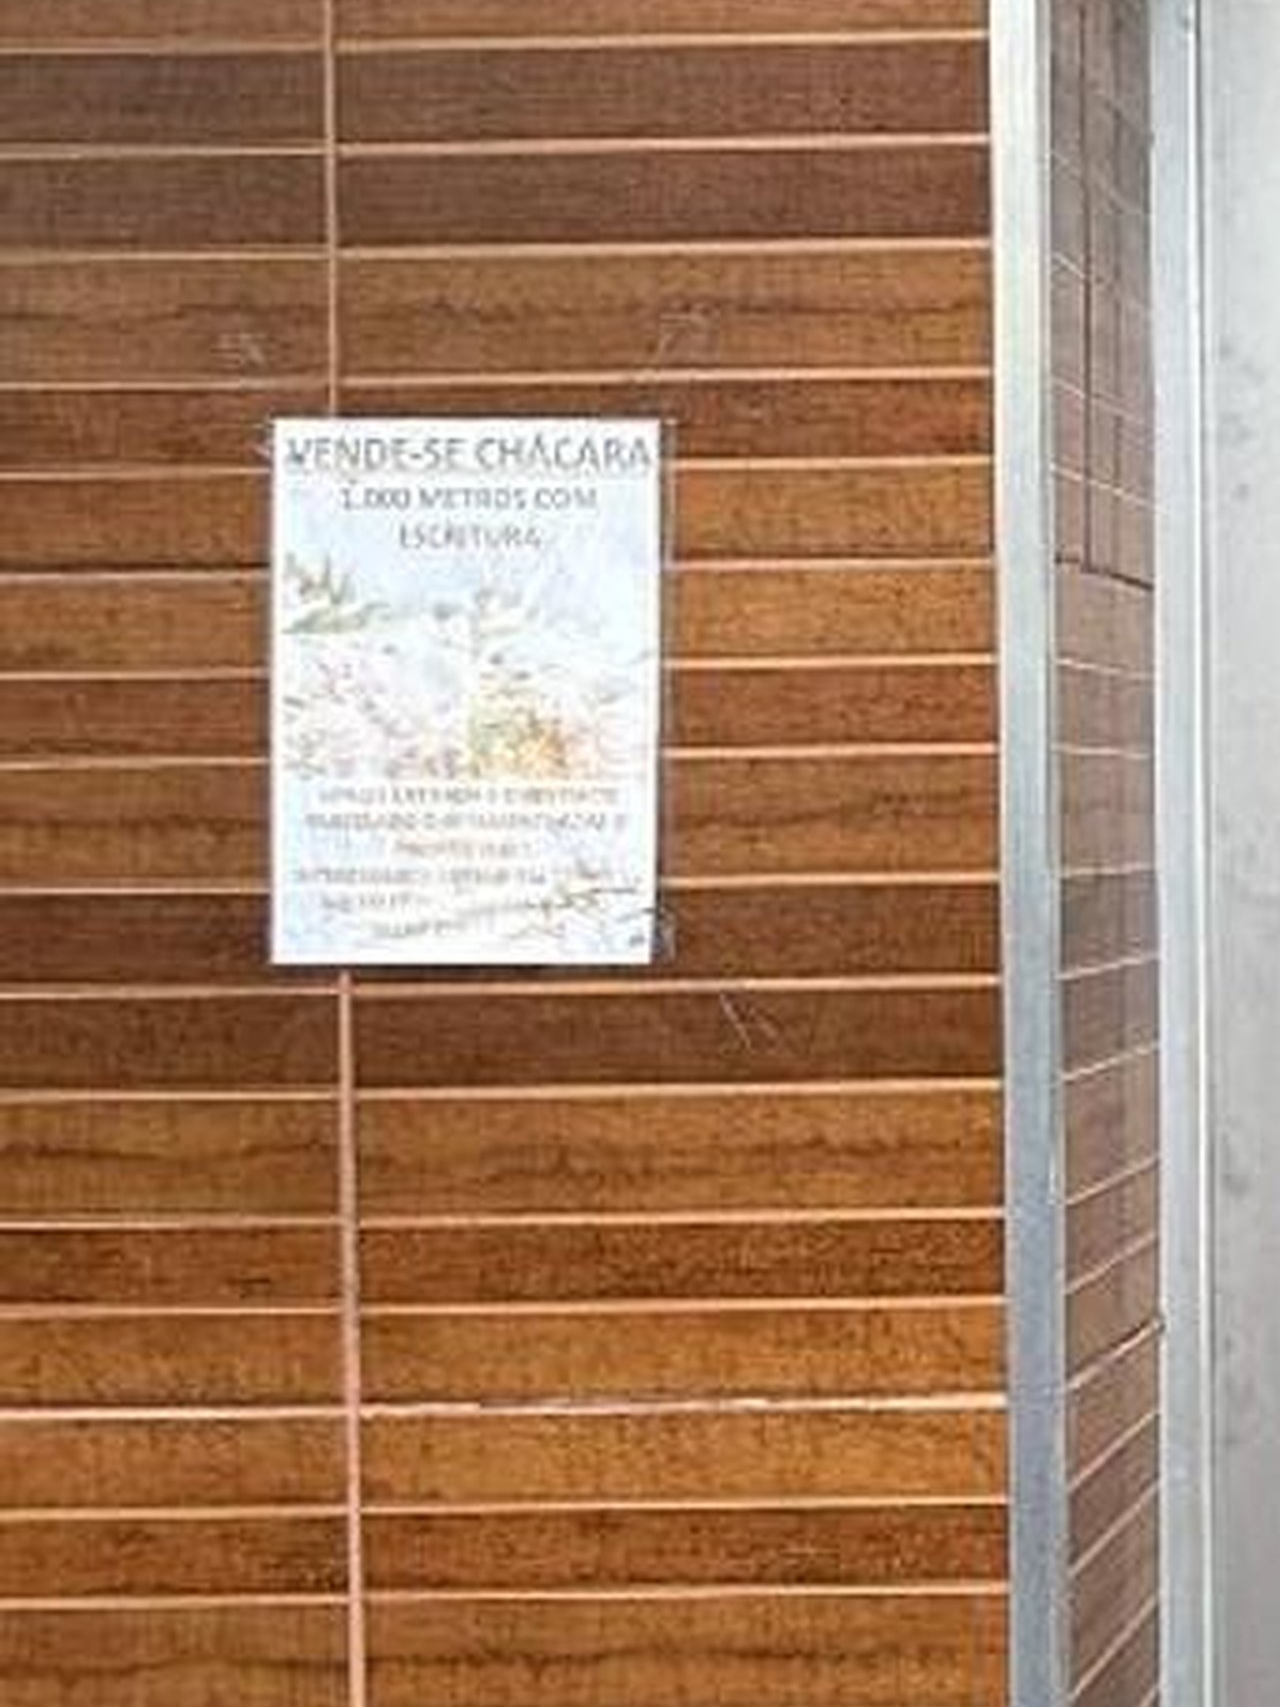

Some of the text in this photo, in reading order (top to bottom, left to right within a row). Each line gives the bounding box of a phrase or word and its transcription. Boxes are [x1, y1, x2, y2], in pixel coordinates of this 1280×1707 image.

[286, 432, 652, 472] VENDE-SE CHÁCARA
[341, 487, 598, 511] 1.000 METROS COM
[398, 523, 544, 551] ESCRITURA
